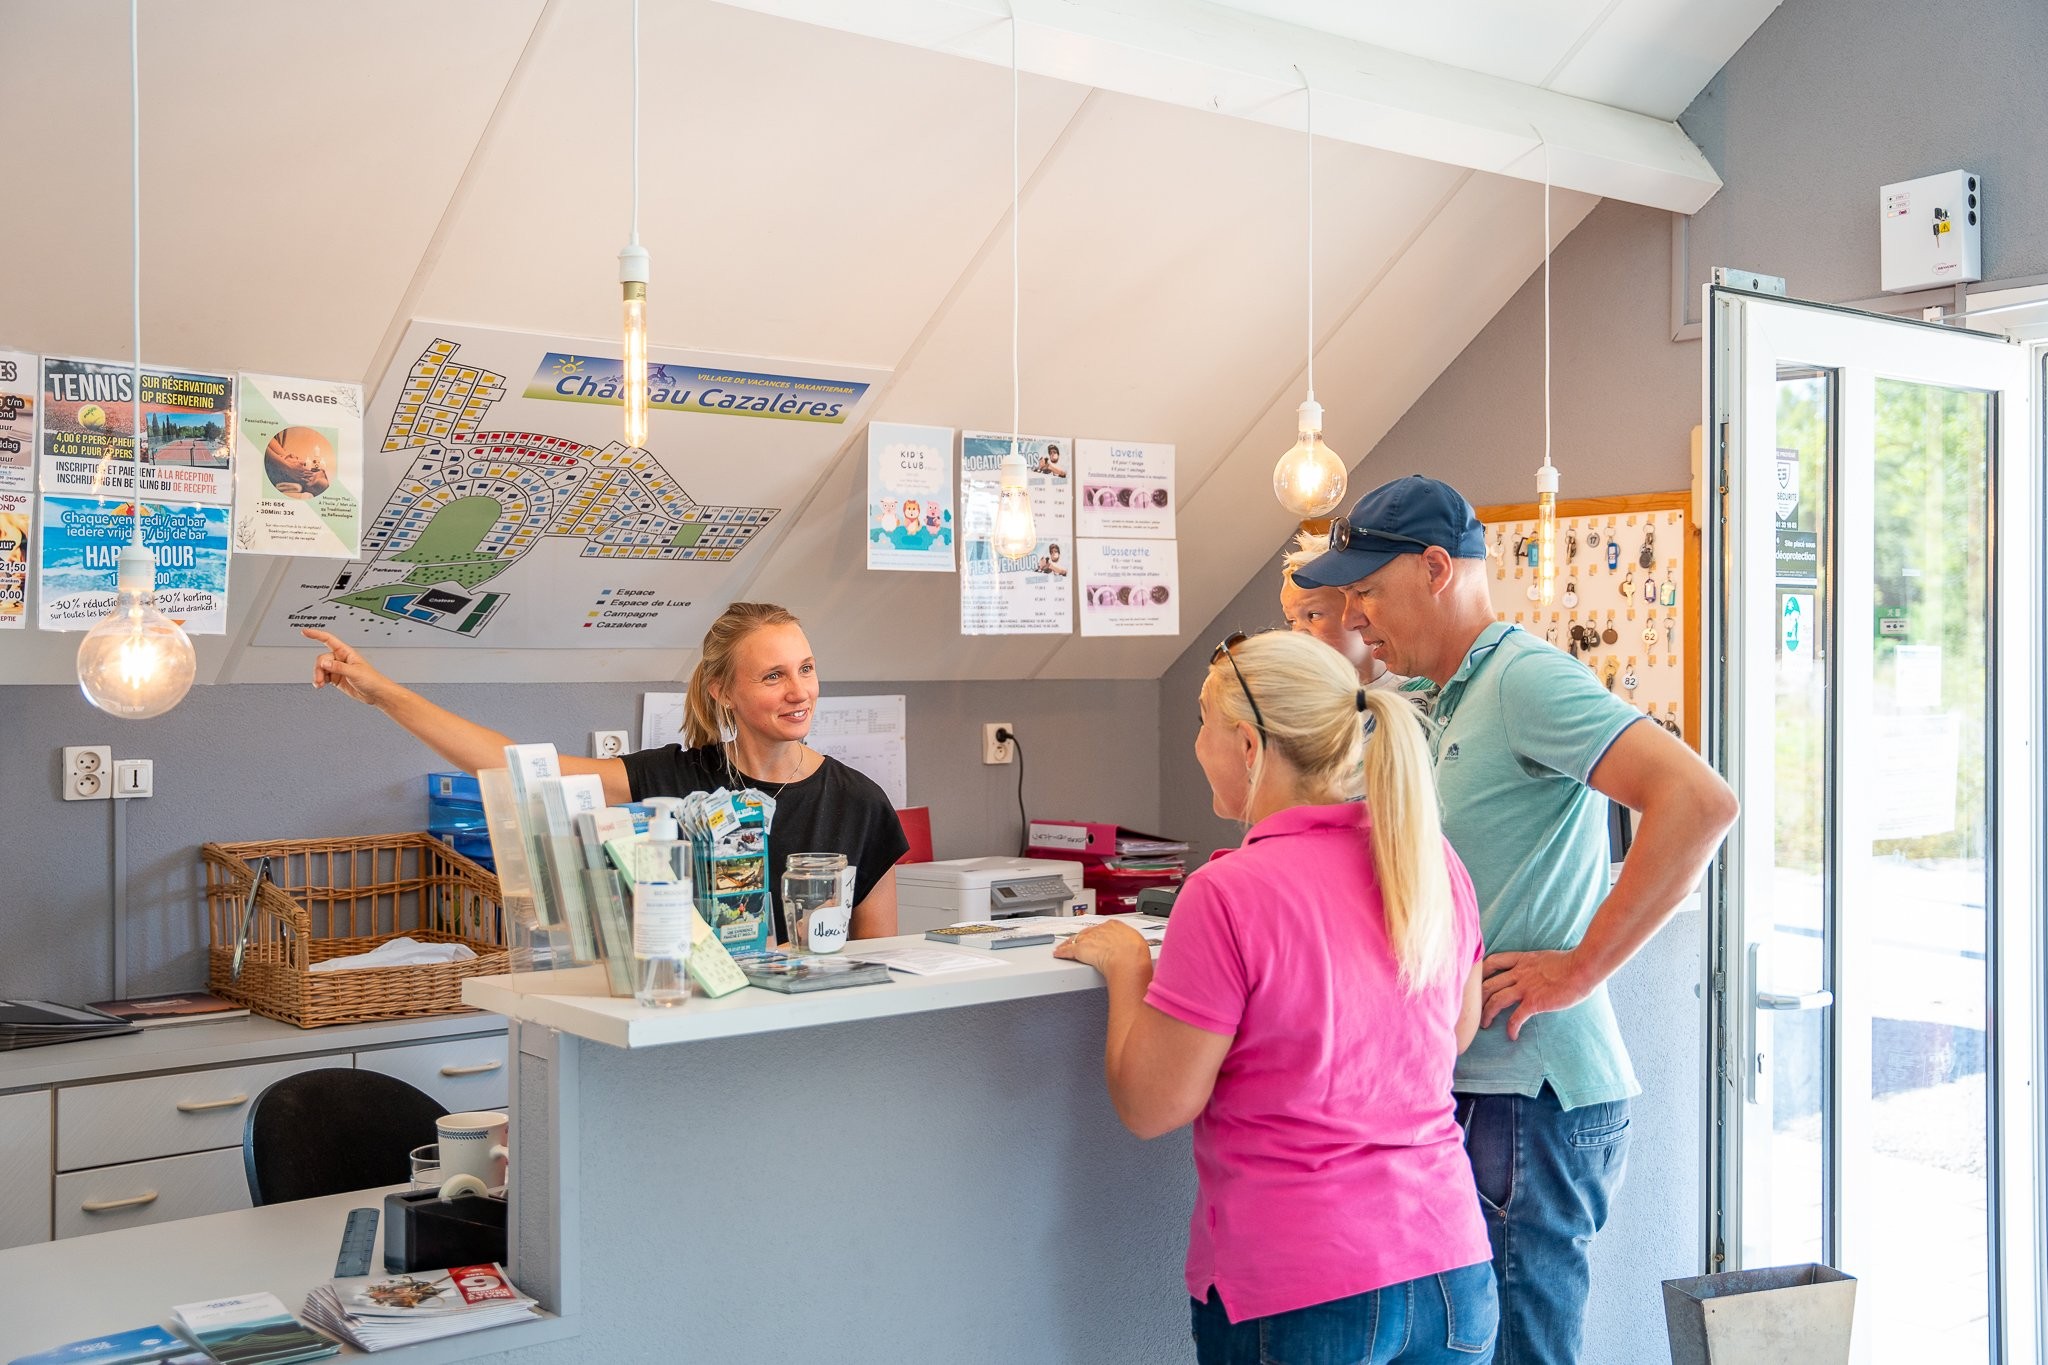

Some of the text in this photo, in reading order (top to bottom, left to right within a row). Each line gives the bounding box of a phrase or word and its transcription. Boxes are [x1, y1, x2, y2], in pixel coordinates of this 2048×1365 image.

[49, 373, 132, 402] TENNIS
[142, 376, 224, 396] SUR RÉSERVATIONS
[697, 373, 856, 395] VILLAGE DE VACANCES VAKANTIEPARK
[7, 398, 22, 407] t/m
[142, 390, 214, 408] OP RESERVERING
[272, 390, 338, 404] MASSAGES
[556, 375, 843, 418] Châau Cazalères
[56, 434, 74, 444] 4,00
[76, 435, 81, 443] €
[60, 446, 78, 456] 4,00
[1110, 446, 1144, 458] Laverie
[900, 461, 924, 470] CLUB
[964, 454, 1003, 472] LOCATIO
[56, 461, 106, 474] INSCRIPTIO
[108, 465, 116, 474] ET
[157, 467, 162, 478] À
[164, 470, 174, 479] LA
[174, 469, 214, 482] RÉCEPTION
[112, 477, 122, 487] EN
[160, 480, 171, 491] BIJ
[173, 482, 182, 492] DE
[184, 482, 217, 494] RECEPTIE
[62, 512, 109, 528] Chaque
[188, 517, 206, 527] bar
[67, 526, 104, 536] iedere
[108, 526, 146, 540] vrijdg
[157, 528, 170, 541] bij
[172, 529, 186, 540] de
[188, 530, 206, 540] bar
[1590, 536, 1597, 544] 17
[86, 545, 131, 567] HAP
[1102, 546, 1151, 557] Wasserette
[0, 562, 26, 572] 21,50
[154, 572, 170, 585] :00
[183, 592, 212, 605] korting
[616, 588, 656, 597] Espace
[83, 596, 118, 608] réductio
[186, 604, 213, 612] dranken
[610, 599, 648, 608] Espace
[64, 610, 86, 619] toutes
[87, 610, 97, 618] les
[603, 610, 658, 618] Campagne
[1644, 632, 1656, 642] 62
[1624, 677, 1636, 686] 82
[460, 1276, 500, 1292] 9
